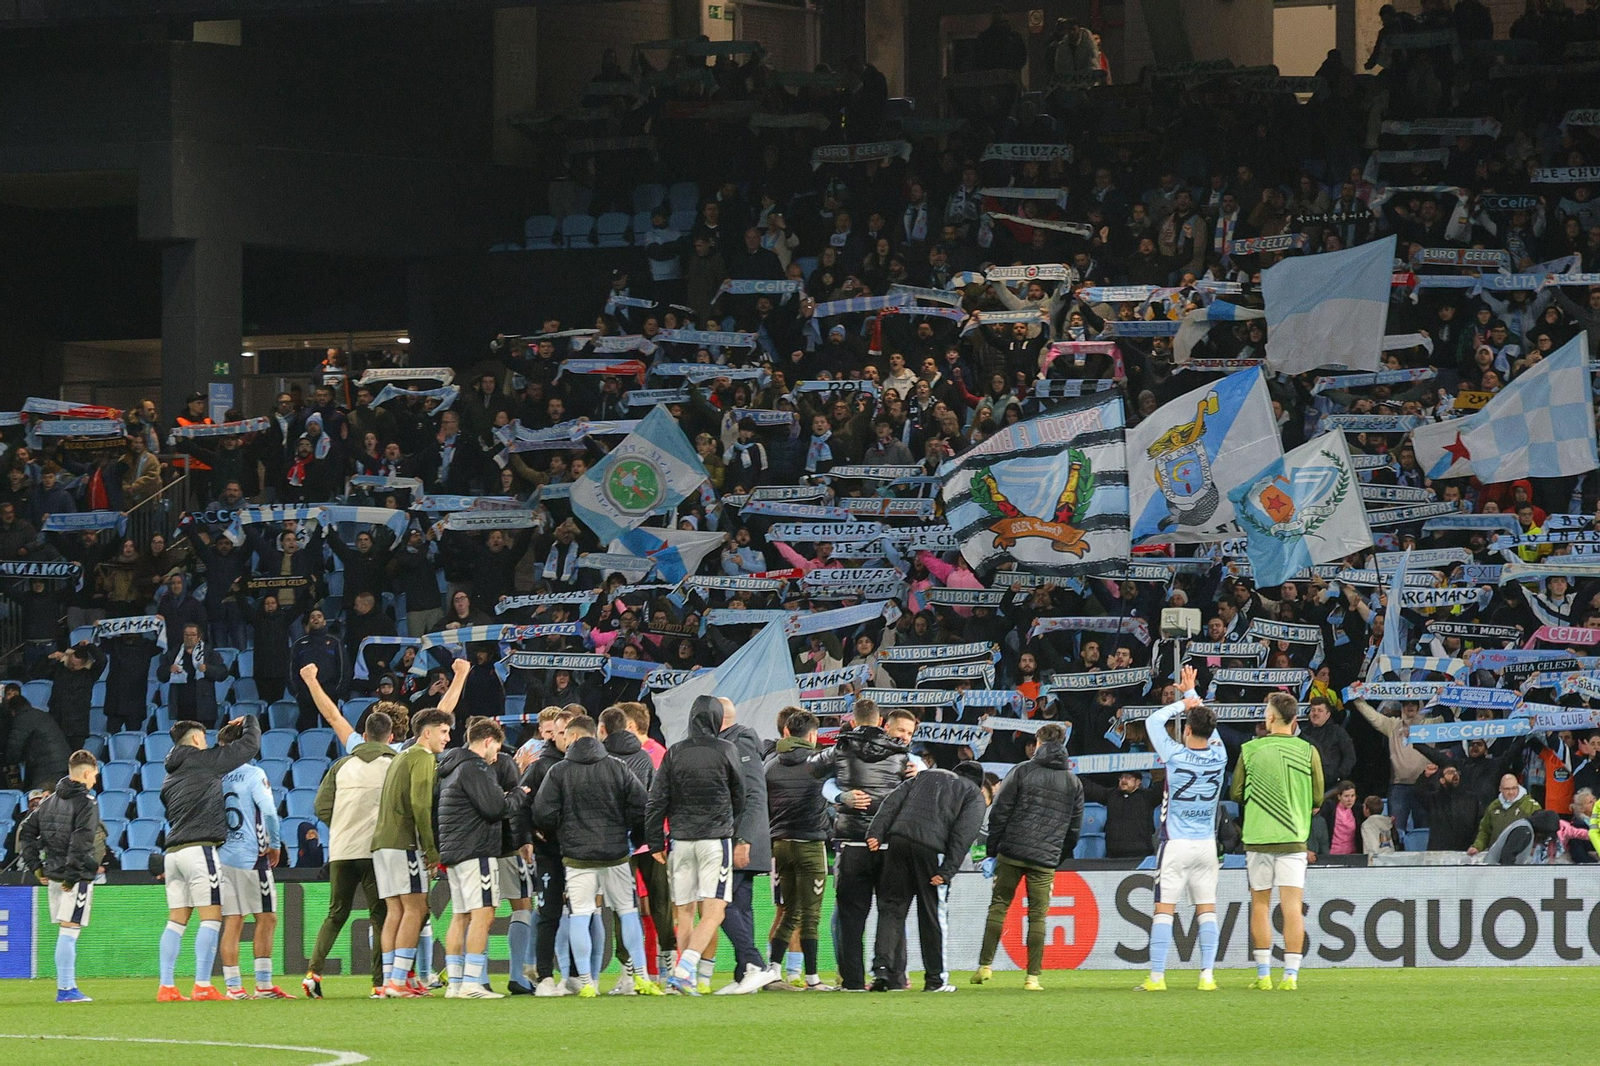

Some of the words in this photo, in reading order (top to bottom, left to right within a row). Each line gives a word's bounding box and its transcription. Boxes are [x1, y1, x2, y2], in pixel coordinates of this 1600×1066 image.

[1423, 248, 1456, 259] EURO
[1464, 251, 1502, 263] CELTA
[1494, 276, 1538, 288] CELTA
[849, 500, 881, 511] EURO
[888, 500, 923, 511] CELTA
[783, 525, 876, 536] LE-CHUZAS
[1466, 565, 1502, 579] EXIL
[935, 591, 975, 603] FUTBOL
[977, 592, 984, 602] E
[1547, 627, 1594, 643] CELTA
[892, 647, 933, 660] FUTBOL
[936, 647, 944, 658] E
[946, 641, 986, 657] BIRRAS
[1219, 643, 1227, 655] E
[512, 654, 550, 667] FUTBOL
[553, 656, 560, 667] E
[562, 656, 603, 668] BIRRAS
[958, 664, 966, 676] E
[1216, 669, 1256, 683] FUTBOL
[1258, 670, 1265, 682] E
[1096, 675, 1104, 687] E
[1105, 671, 1148, 685] BIRRAS
[864, 690, 905, 704] FUTBOL
[907, 690, 915, 703] E
[916, 690, 957, 704] BIRRAS
[1252, 706, 1260, 718] E
[1560, 714, 1584, 726] CLUB
[1436, 723, 1506, 740] RCCelta
[1171, 767, 1222, 803] 23
